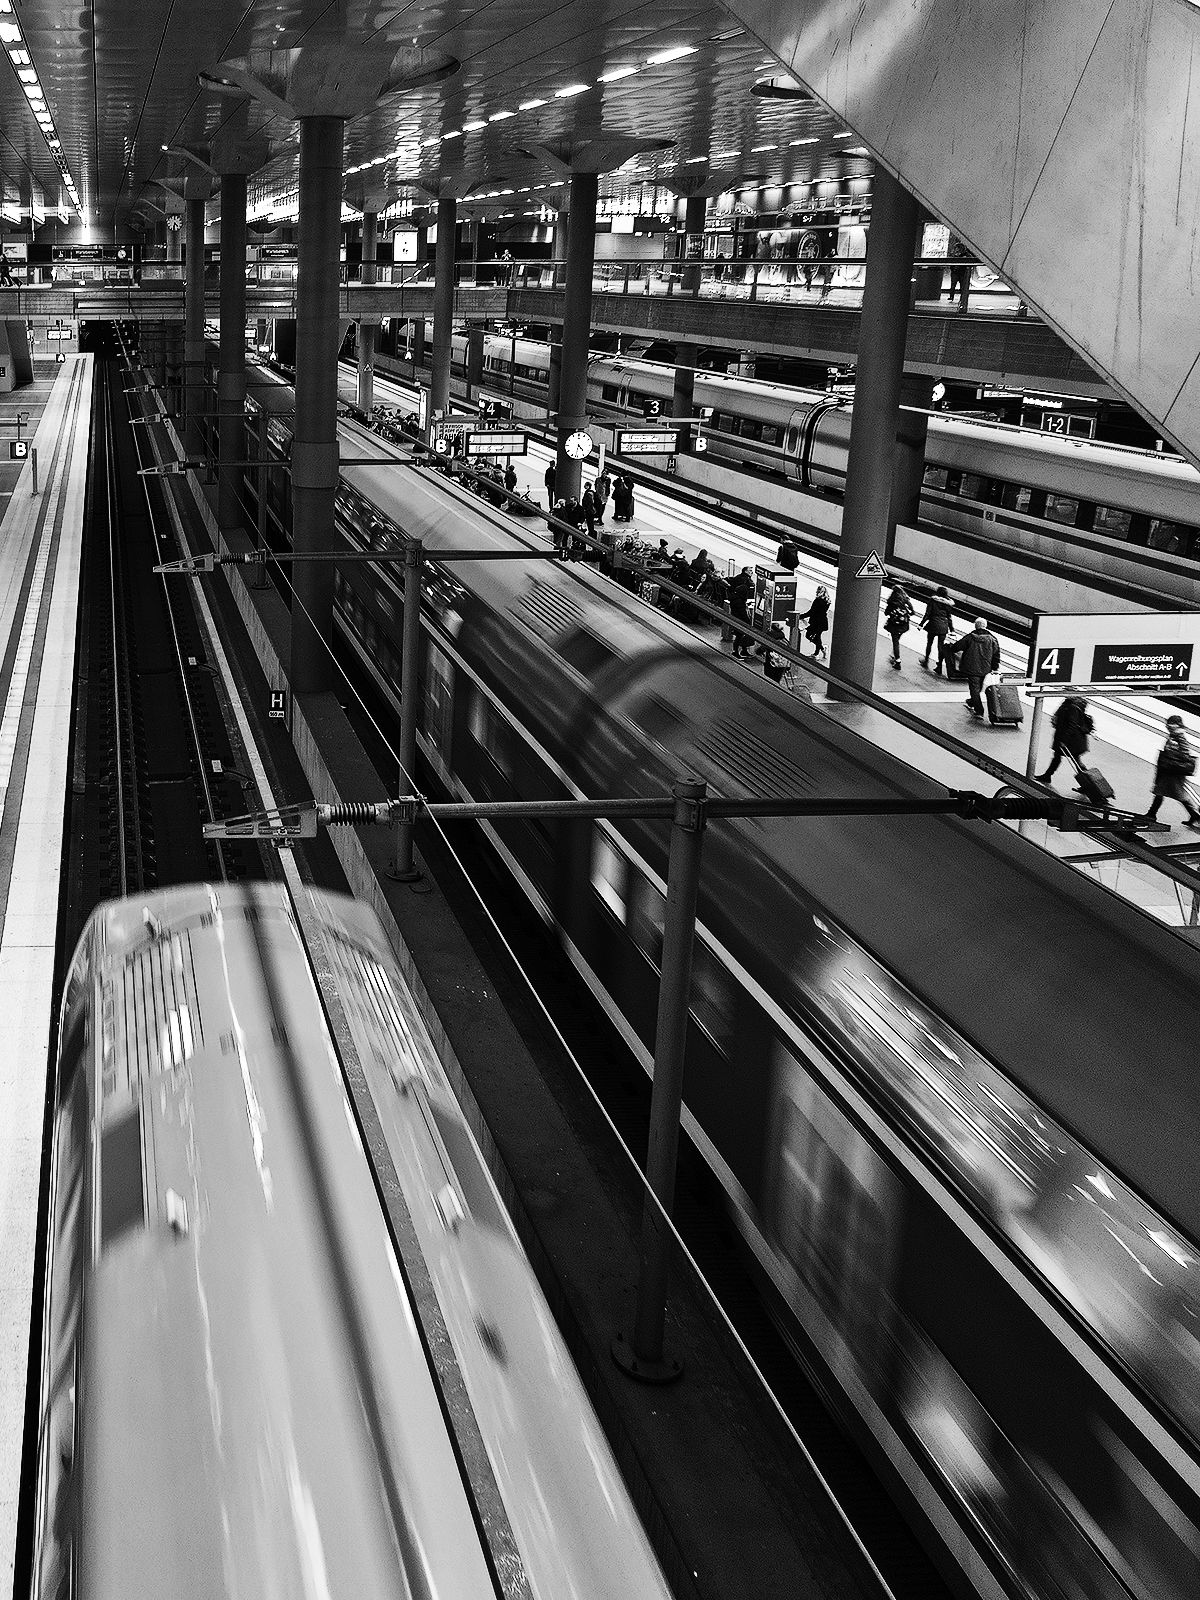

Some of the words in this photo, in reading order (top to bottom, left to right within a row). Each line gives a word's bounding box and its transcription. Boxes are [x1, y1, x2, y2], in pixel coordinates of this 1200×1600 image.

[486, 402, 495, 415] 4
[650, 400, 660, 414] 3
[1047, 416, 1064, 433] 1-2
[15, 443, 27, 456] B
[436, 439, 447, 453] B
[696, 437, 707, 451] B
[1041, 649, 1059, 675] 4
[1108, 655, 1173, 663] Wagenreihungsplan
[271, 693, 283, 708] H
